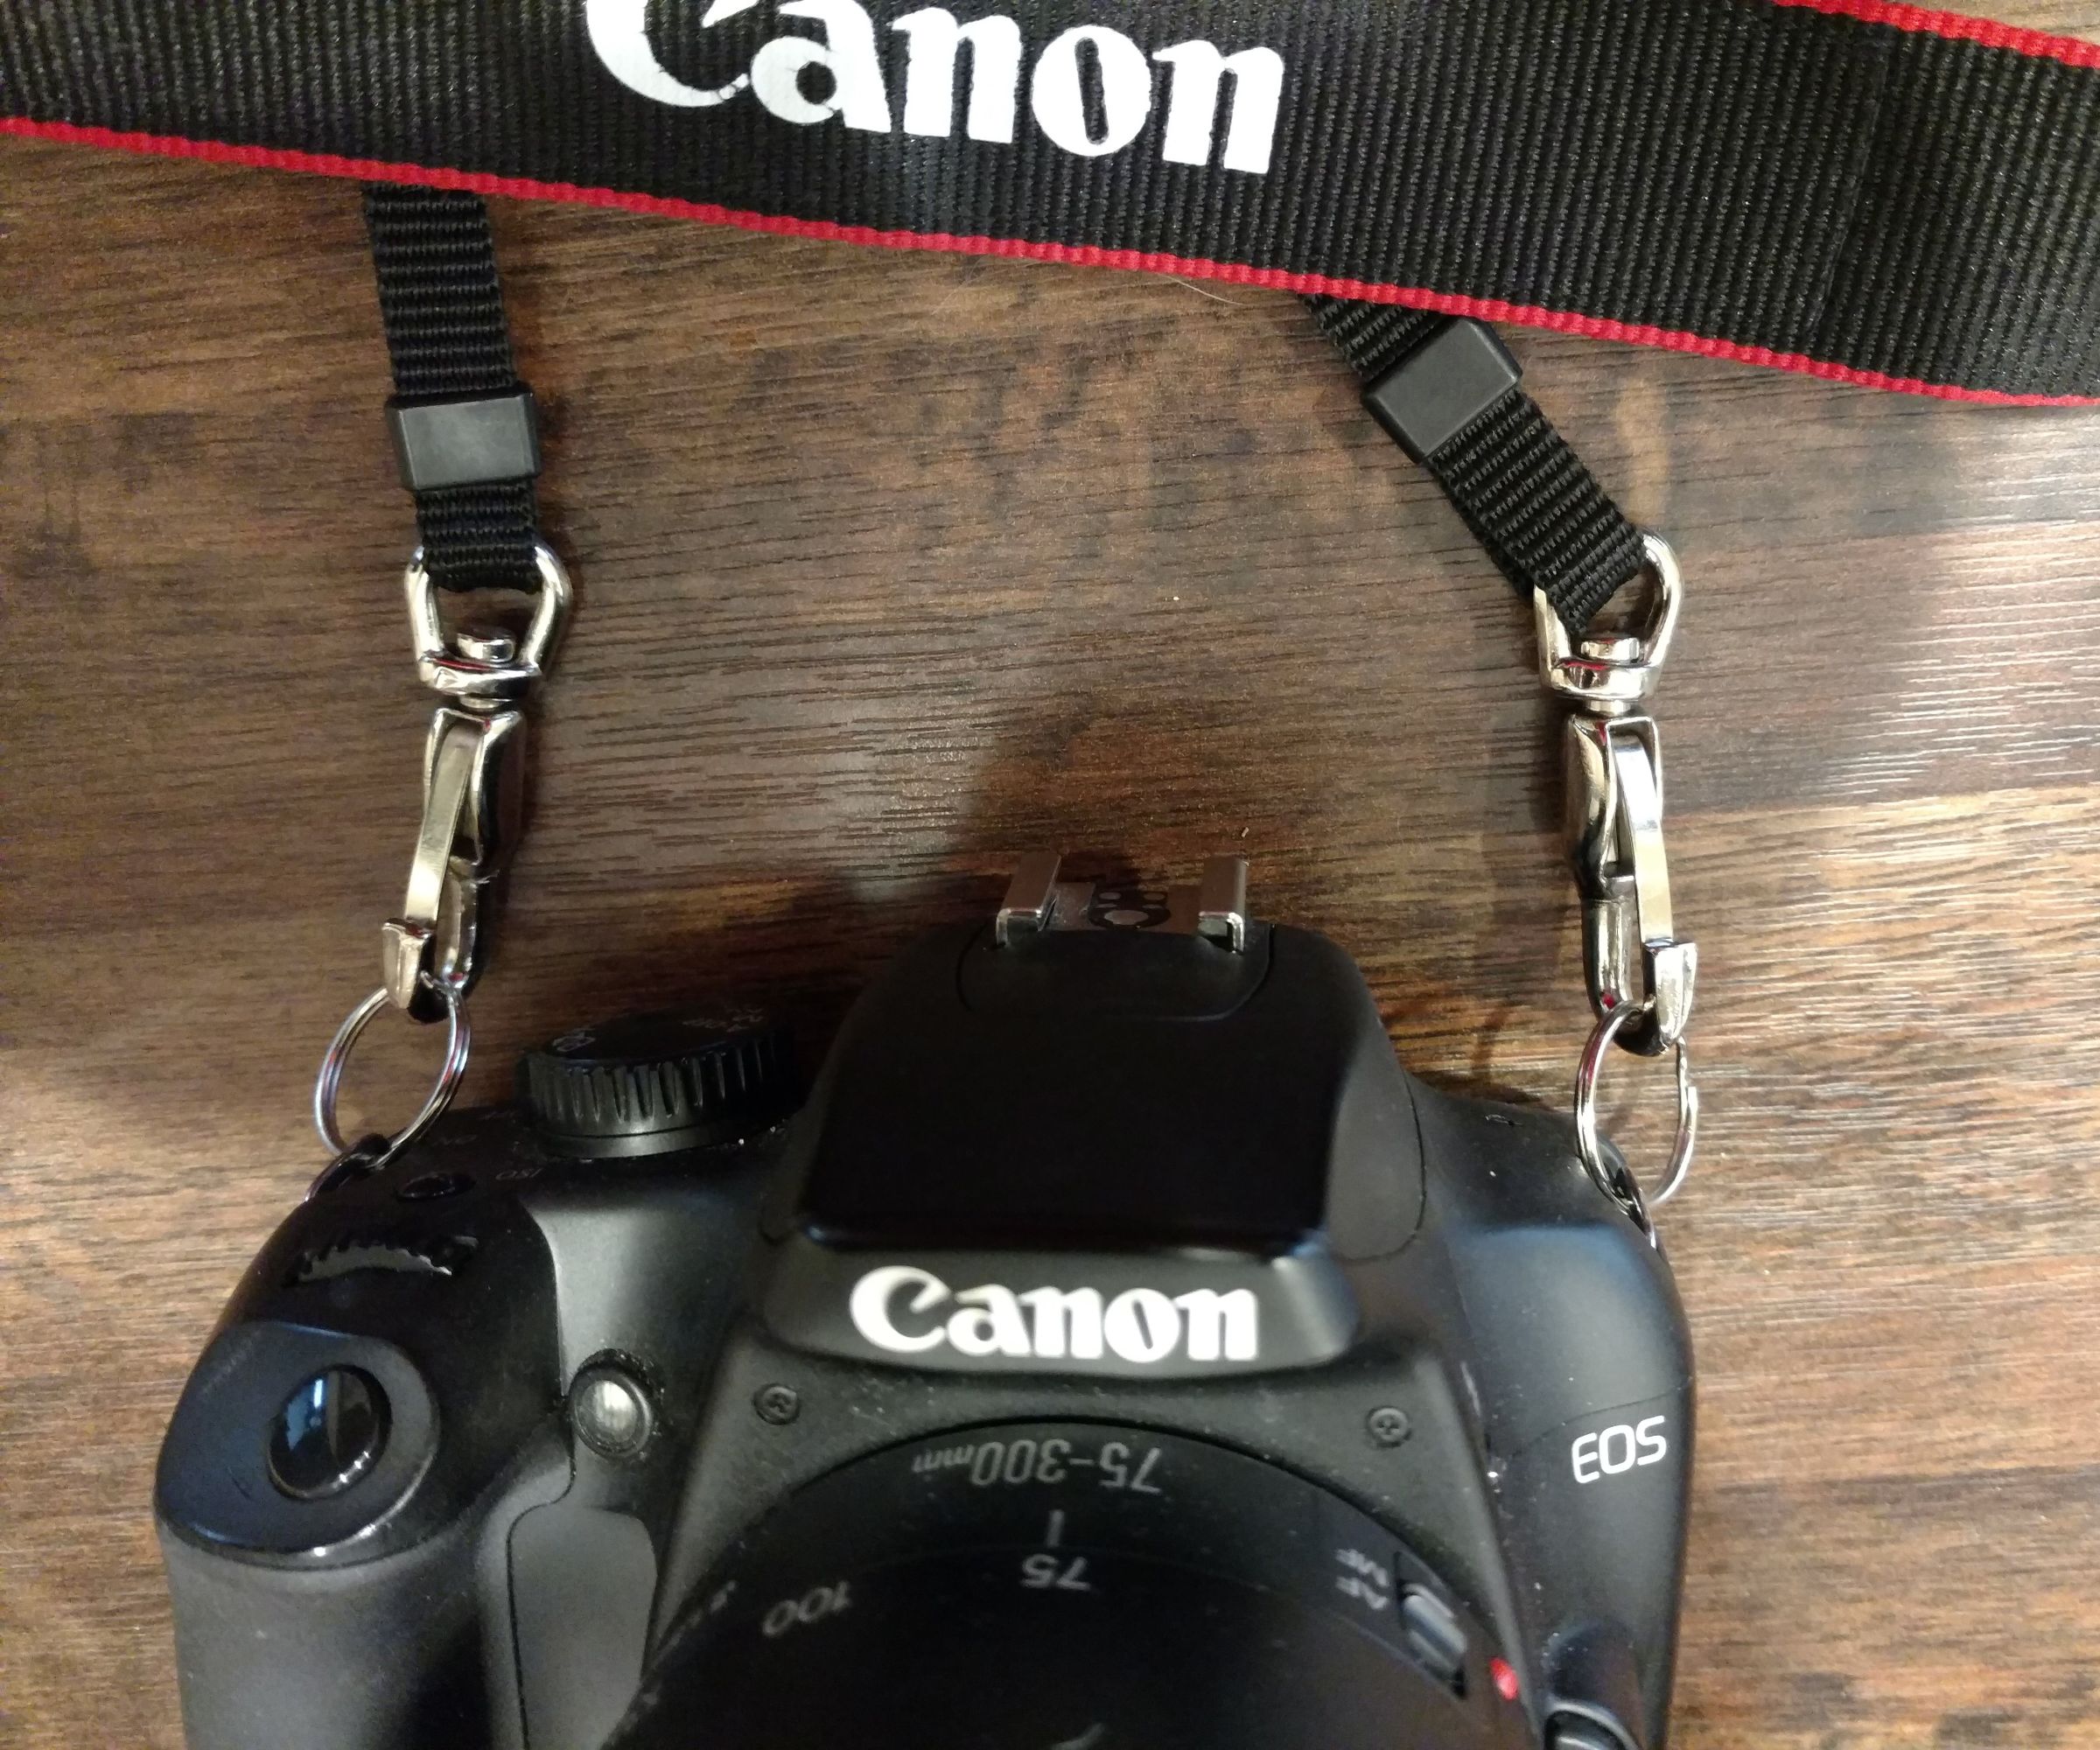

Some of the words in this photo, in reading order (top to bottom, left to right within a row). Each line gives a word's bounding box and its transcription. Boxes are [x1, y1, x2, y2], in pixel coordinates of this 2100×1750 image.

[586, 0, 1284, 174] Canon
[849, 1265, 1257, 1362] Canon
[911, 1438, 1164, 1494] 75-300mm
[1571, 1415, 1668, 1484] EOS
[1021, 1554, 1092, 1591] 75
[762, 1580, 851, 1637] 100
